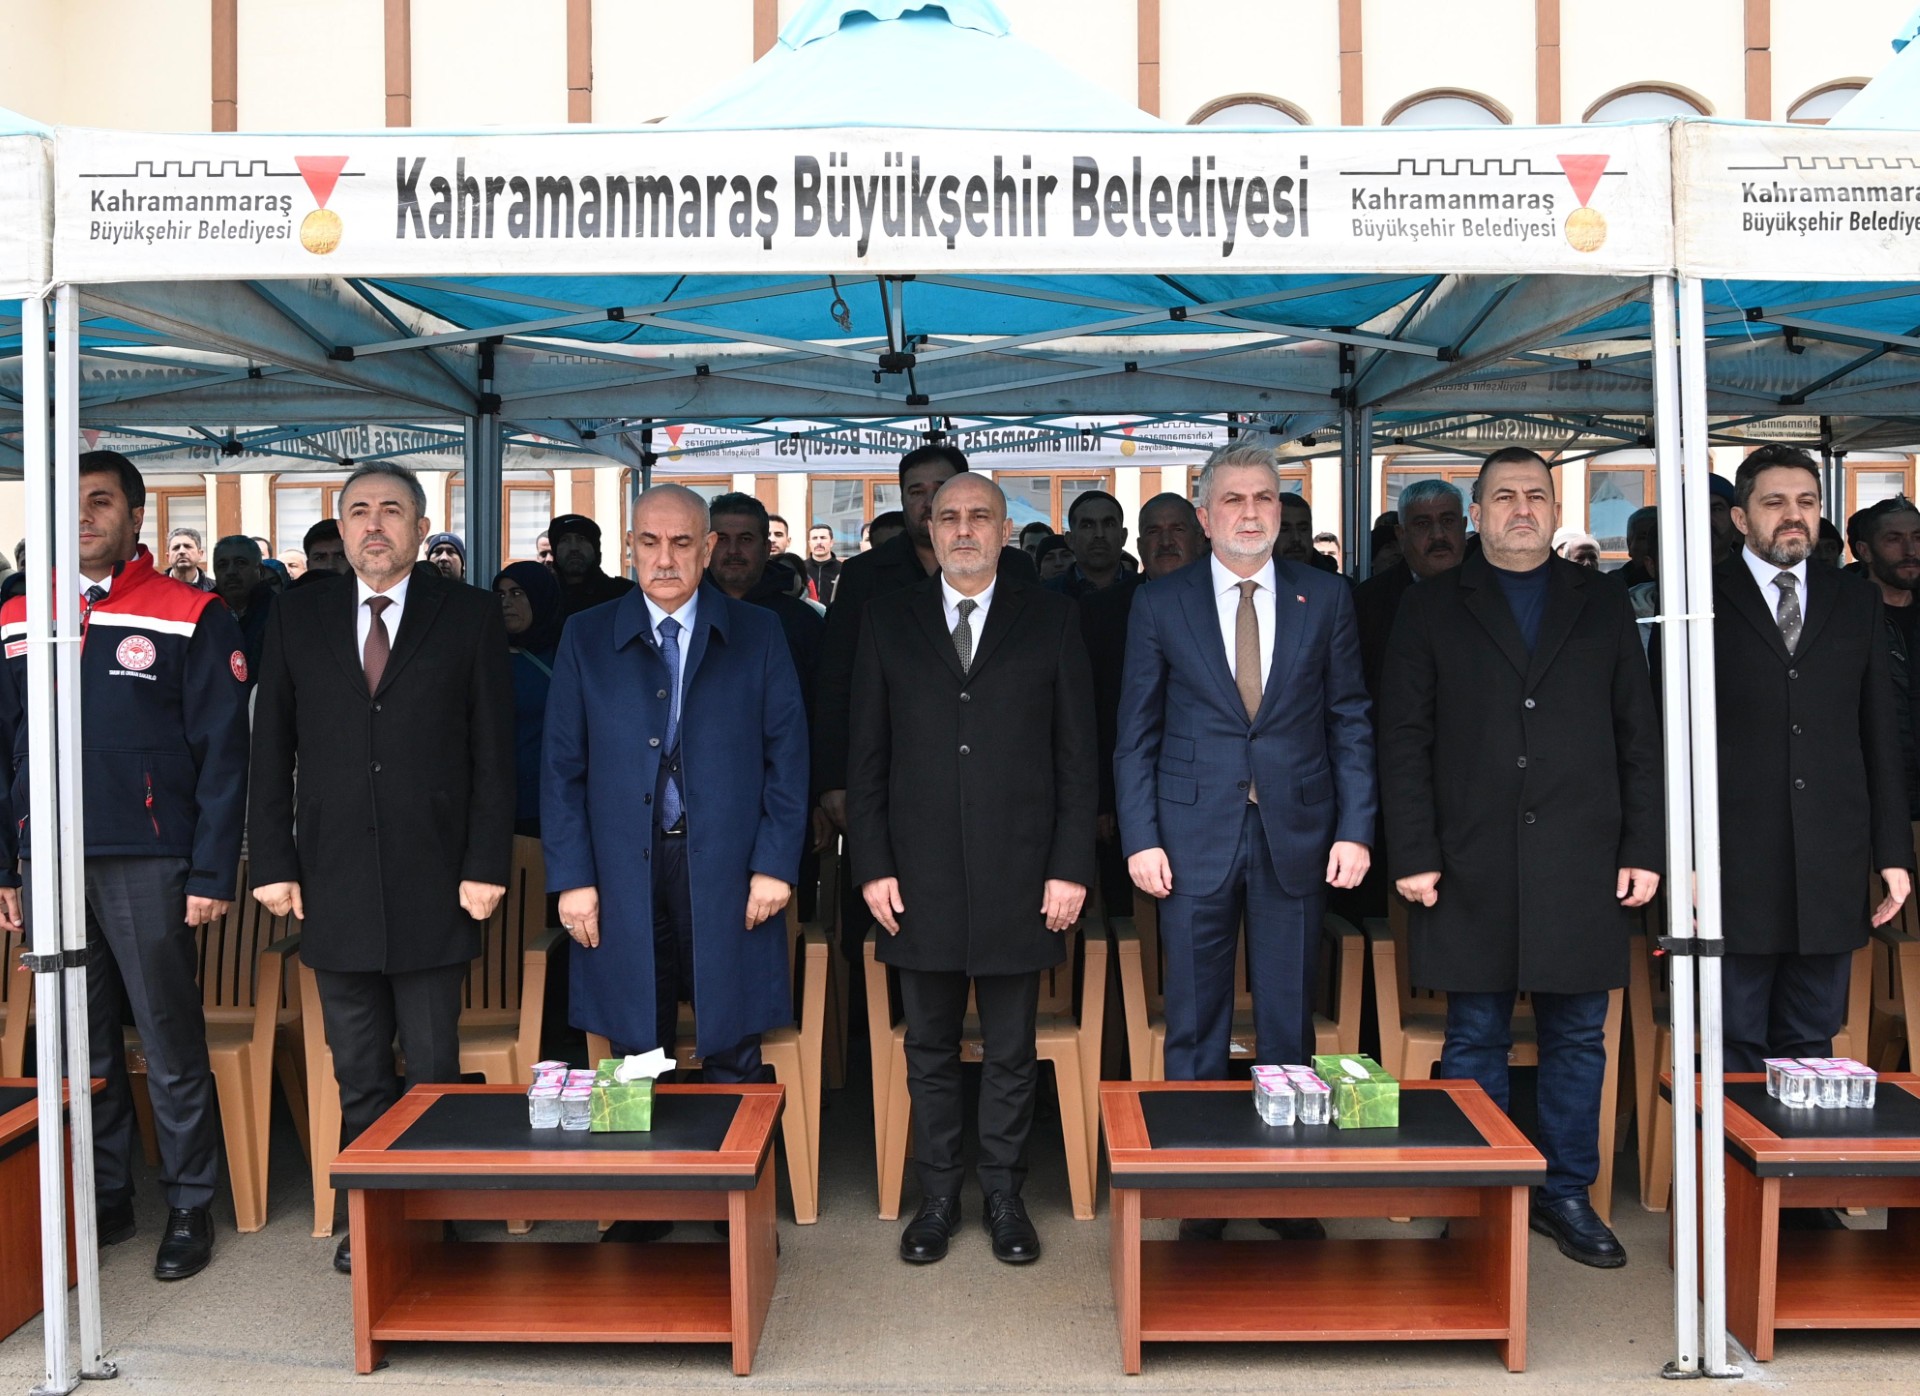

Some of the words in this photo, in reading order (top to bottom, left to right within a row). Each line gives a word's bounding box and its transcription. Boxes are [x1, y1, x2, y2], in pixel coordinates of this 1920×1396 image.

[91, 189, 293, 217] Kahramanmaraş
[396, 156, 779, 250] Kahramanmaraş
[794, 152, 1058, 258] Büyükşehir
[1073, 156, 1309, 258] Belediyesi
[1351, 187, 1555, 215] Kahramanmaraş
[90, 220, 192, 245] Büyükşehir
[198, 220, 292, 244] Belediyesi
[1352, 218, 1456, 242] Büyükşehir
[1462, 218, 1556, 242] Belediyesi
[1743, 211, 1843, 237] Büyükşehir
